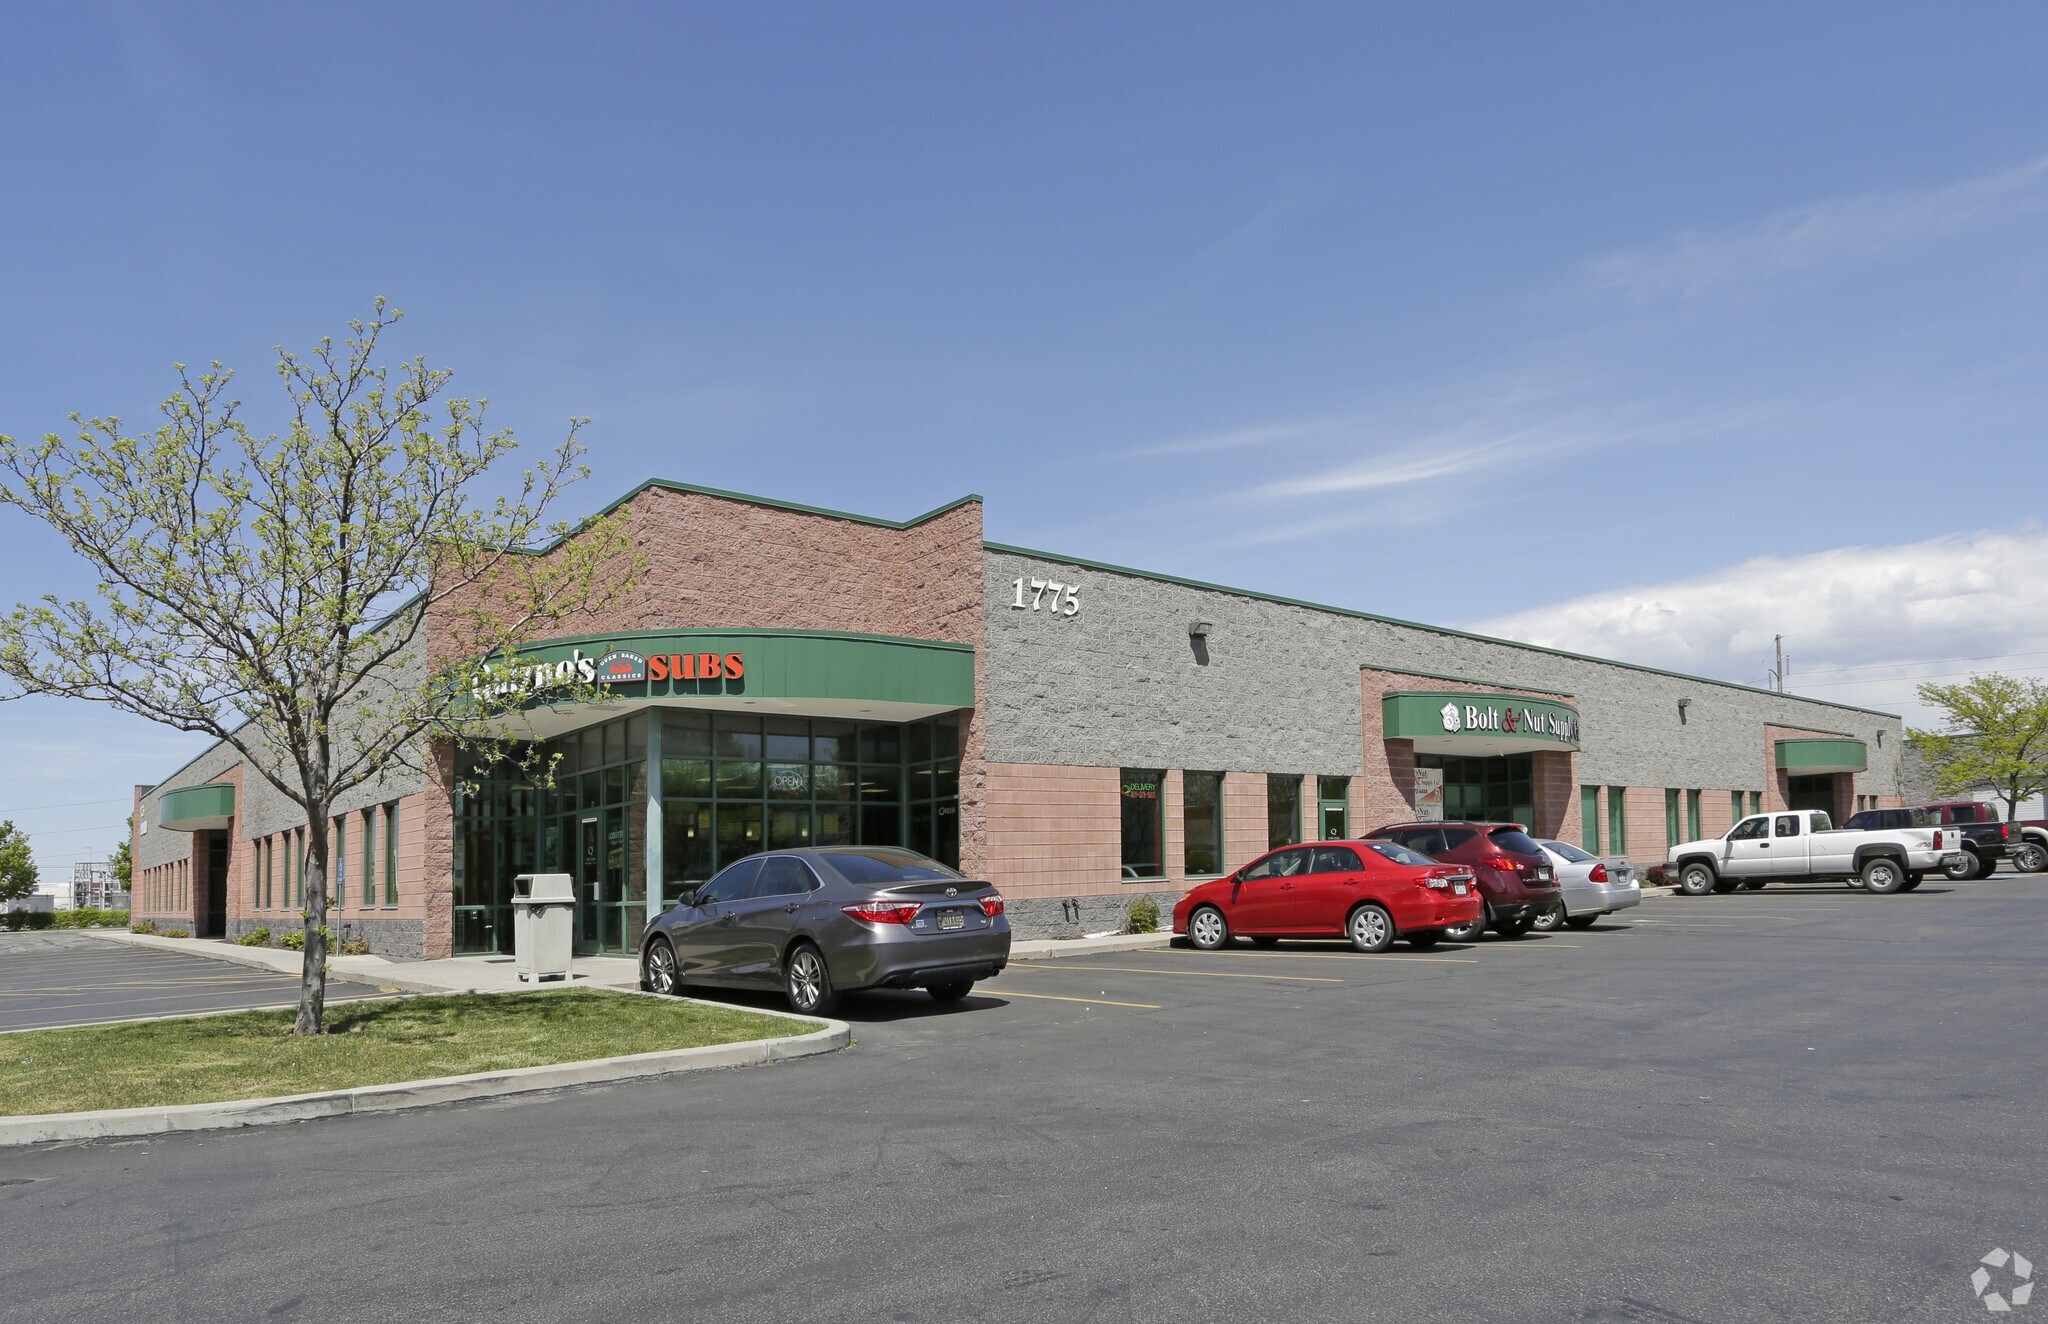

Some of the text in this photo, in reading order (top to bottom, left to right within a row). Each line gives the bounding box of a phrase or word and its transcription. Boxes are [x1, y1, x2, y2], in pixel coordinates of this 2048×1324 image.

[1011, 576, 1080, 616] 1775
[621, 653, 643, 664] BAKED
[648, 653, 744, 681] SUBS
[1465, 705, 1499, 730] Bolt
[1502, 707, 1523, 733] &
[1523, 708, 1545, 733] Nut
[774, 776, 799, 786] OPEN
[1130, 783, 1156, 791] DELIVERY
